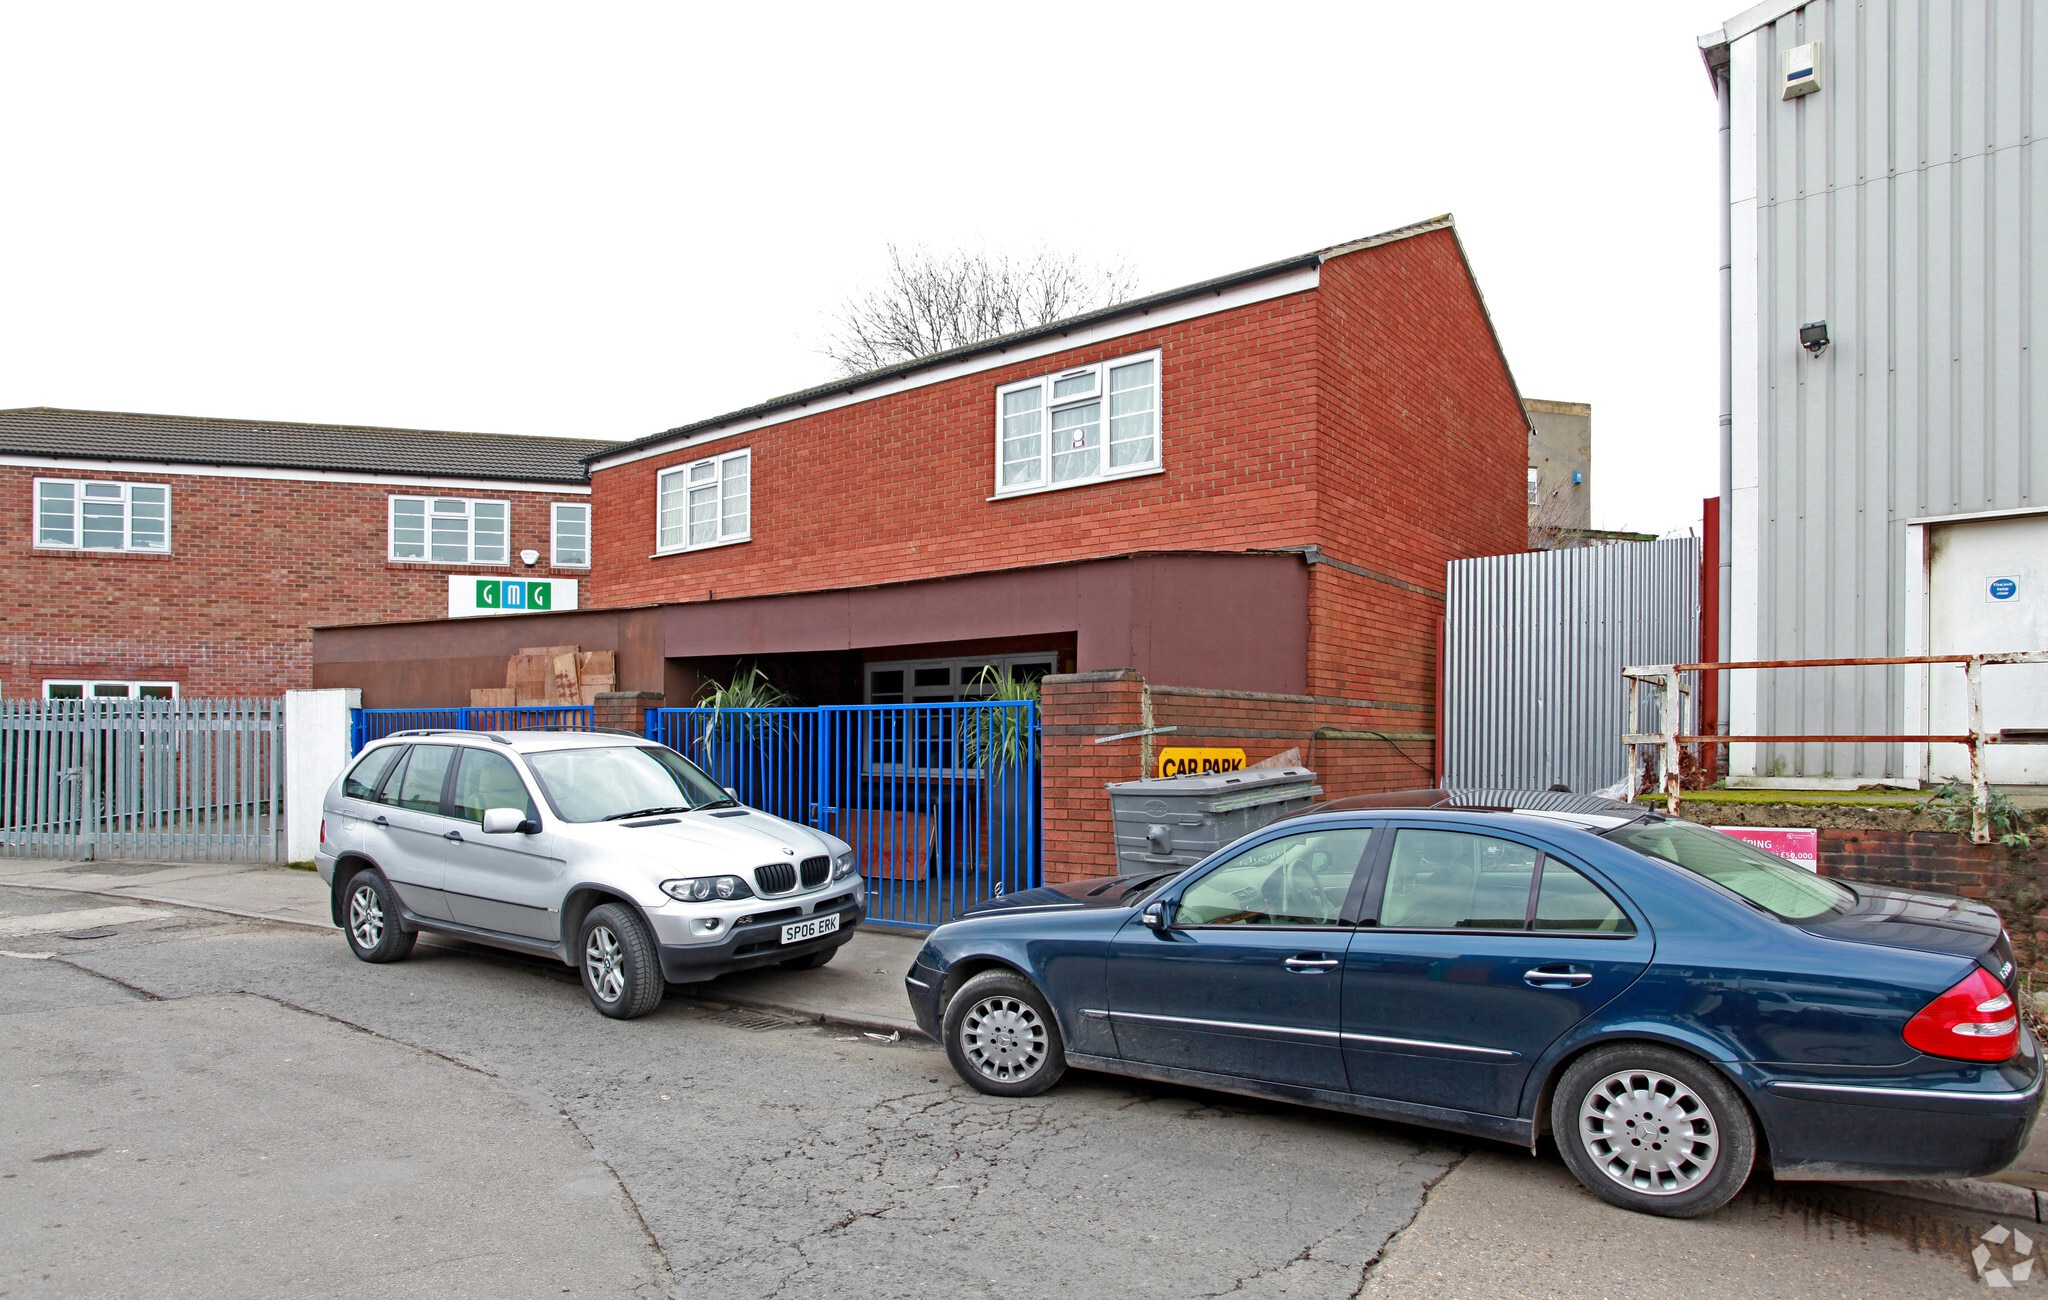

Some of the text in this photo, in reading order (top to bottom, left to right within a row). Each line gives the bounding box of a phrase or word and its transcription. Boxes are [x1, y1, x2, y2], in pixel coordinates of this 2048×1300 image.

[1162, 758, 1242, 778] CAR PARK
[786, 916, 837, 941] SP06 ERK
